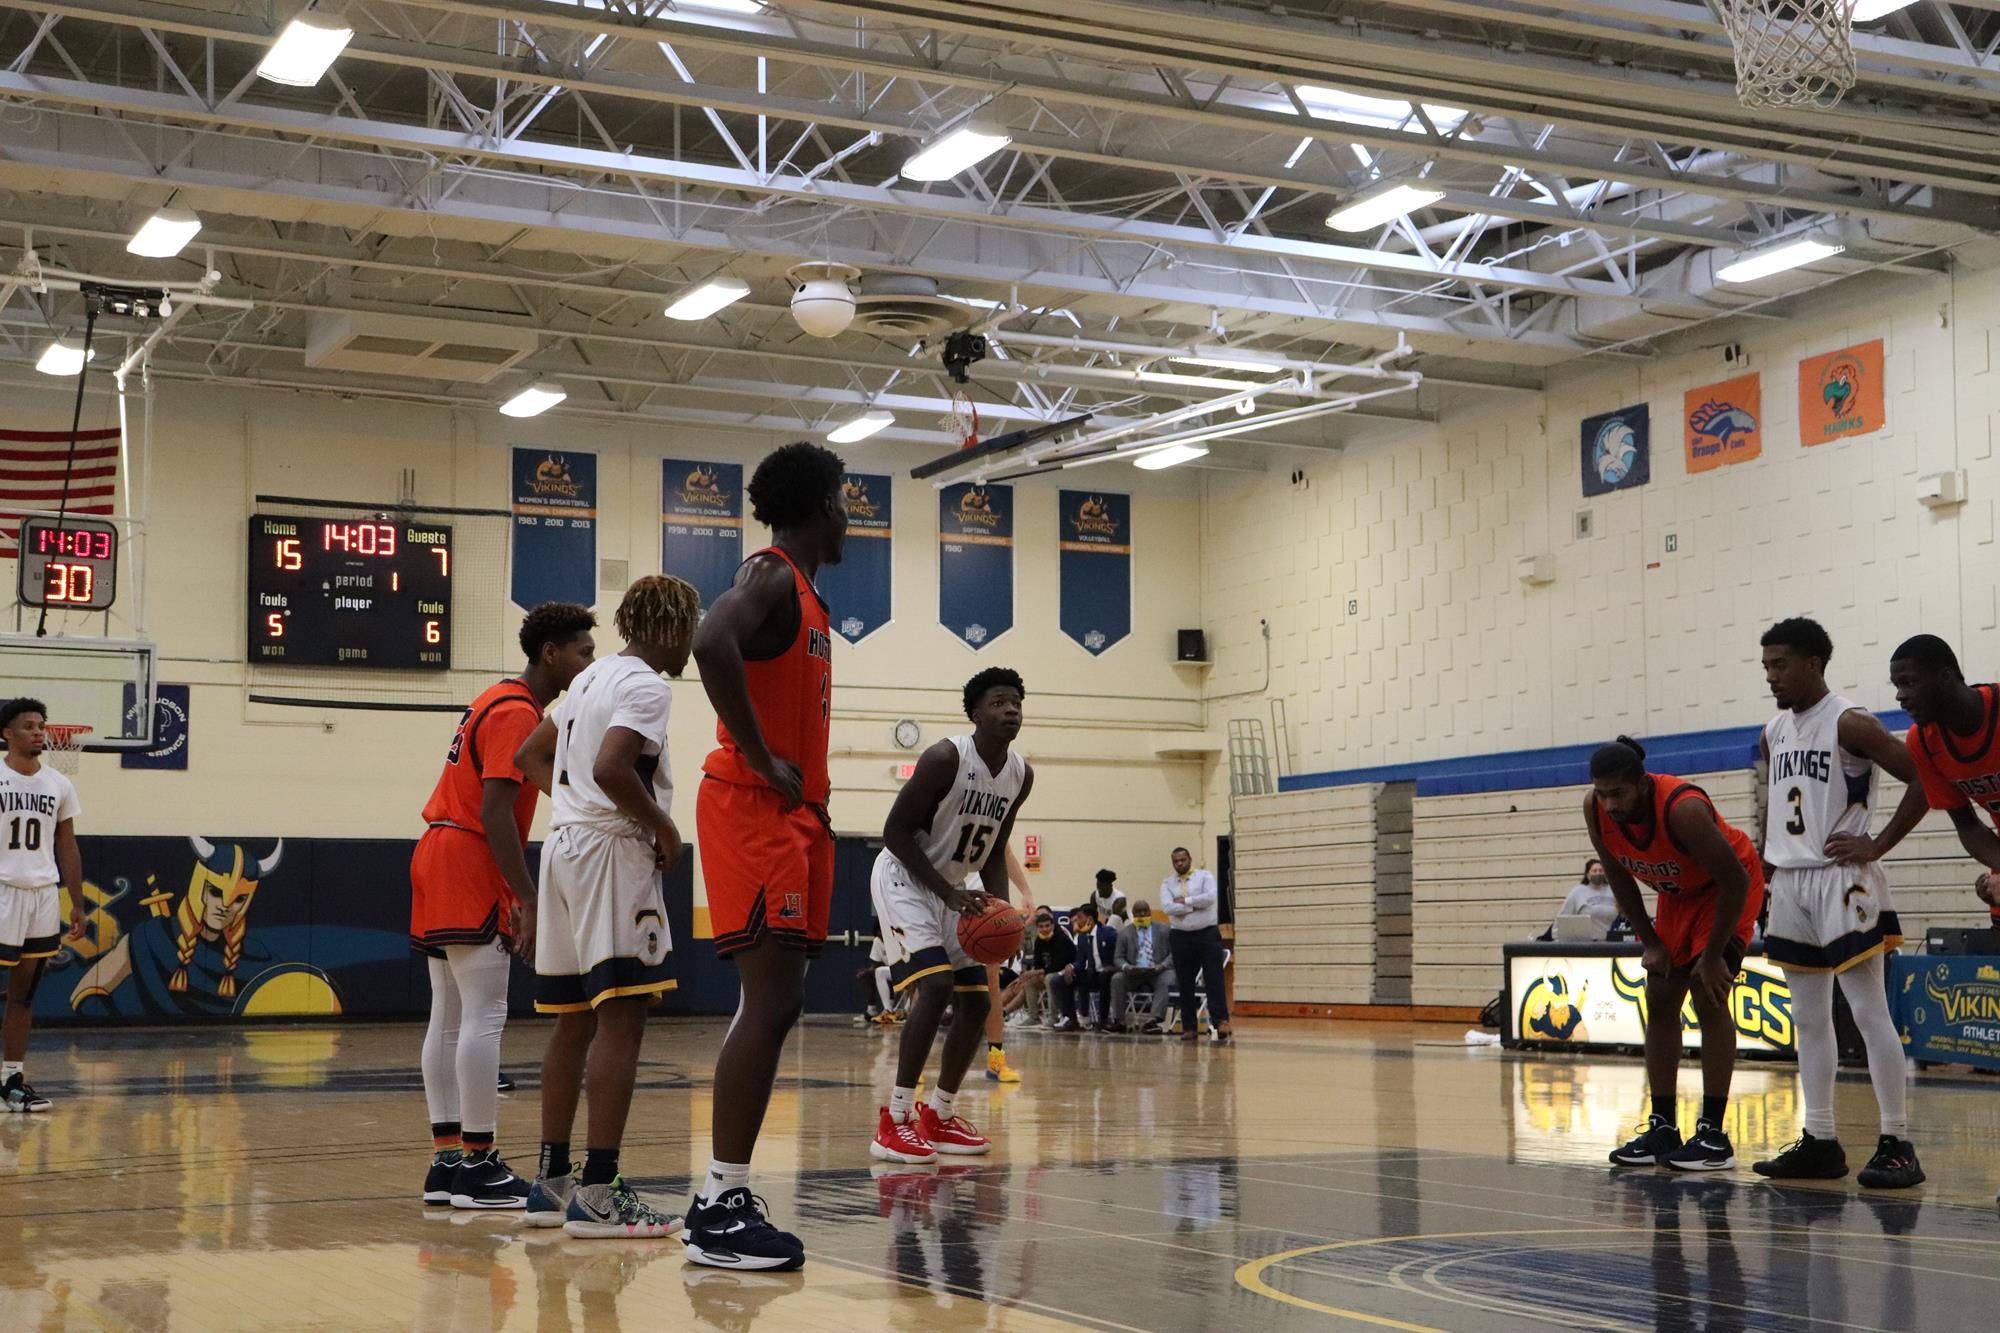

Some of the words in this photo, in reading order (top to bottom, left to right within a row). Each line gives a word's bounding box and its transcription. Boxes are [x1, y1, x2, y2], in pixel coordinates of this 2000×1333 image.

[1823, 416, 1863, 435] HAWKS
[531, 481, 577, 497] VIKINGS
[681, 492, 724, 507] VIKINGS
[544, 518, 564, 527] 2010
[958, 512, 996, 526] VIKINGS
[1077, 520, 1114, 534] VIKINGS
[264, 520, 297, 536] Home
[407, 529, 447, 544] Guests
[39, 529, 110, 559] 14:03
[324, 523, 396, 556] 14:03
[276, 540, 302, 570] 15
[431, 547, 447, 577] 7
[45, 563, 92, 602] 30
[335, 575, 373, 588] period
[392, 571, 399, 591] 1
[260, 592, 287, 607] fouls
[335, 596, 373, 610] player
[418, 601, 444, 614] fouls
[268, 613, 283, 637] 5
[426, 620, 441, 643] 6
[262, 646, 285, 656] won
[338, 648, 367, 661] game
[420, 652, 442, 662] won
[1773, 750, 1831, 785] VIKINGS
[0, 791, 56, 817] VIKINGS
[1786, 786, 1806, 836] 3
[8, 816, 41, 851] 10
[951, 821, 994, 864] 15
